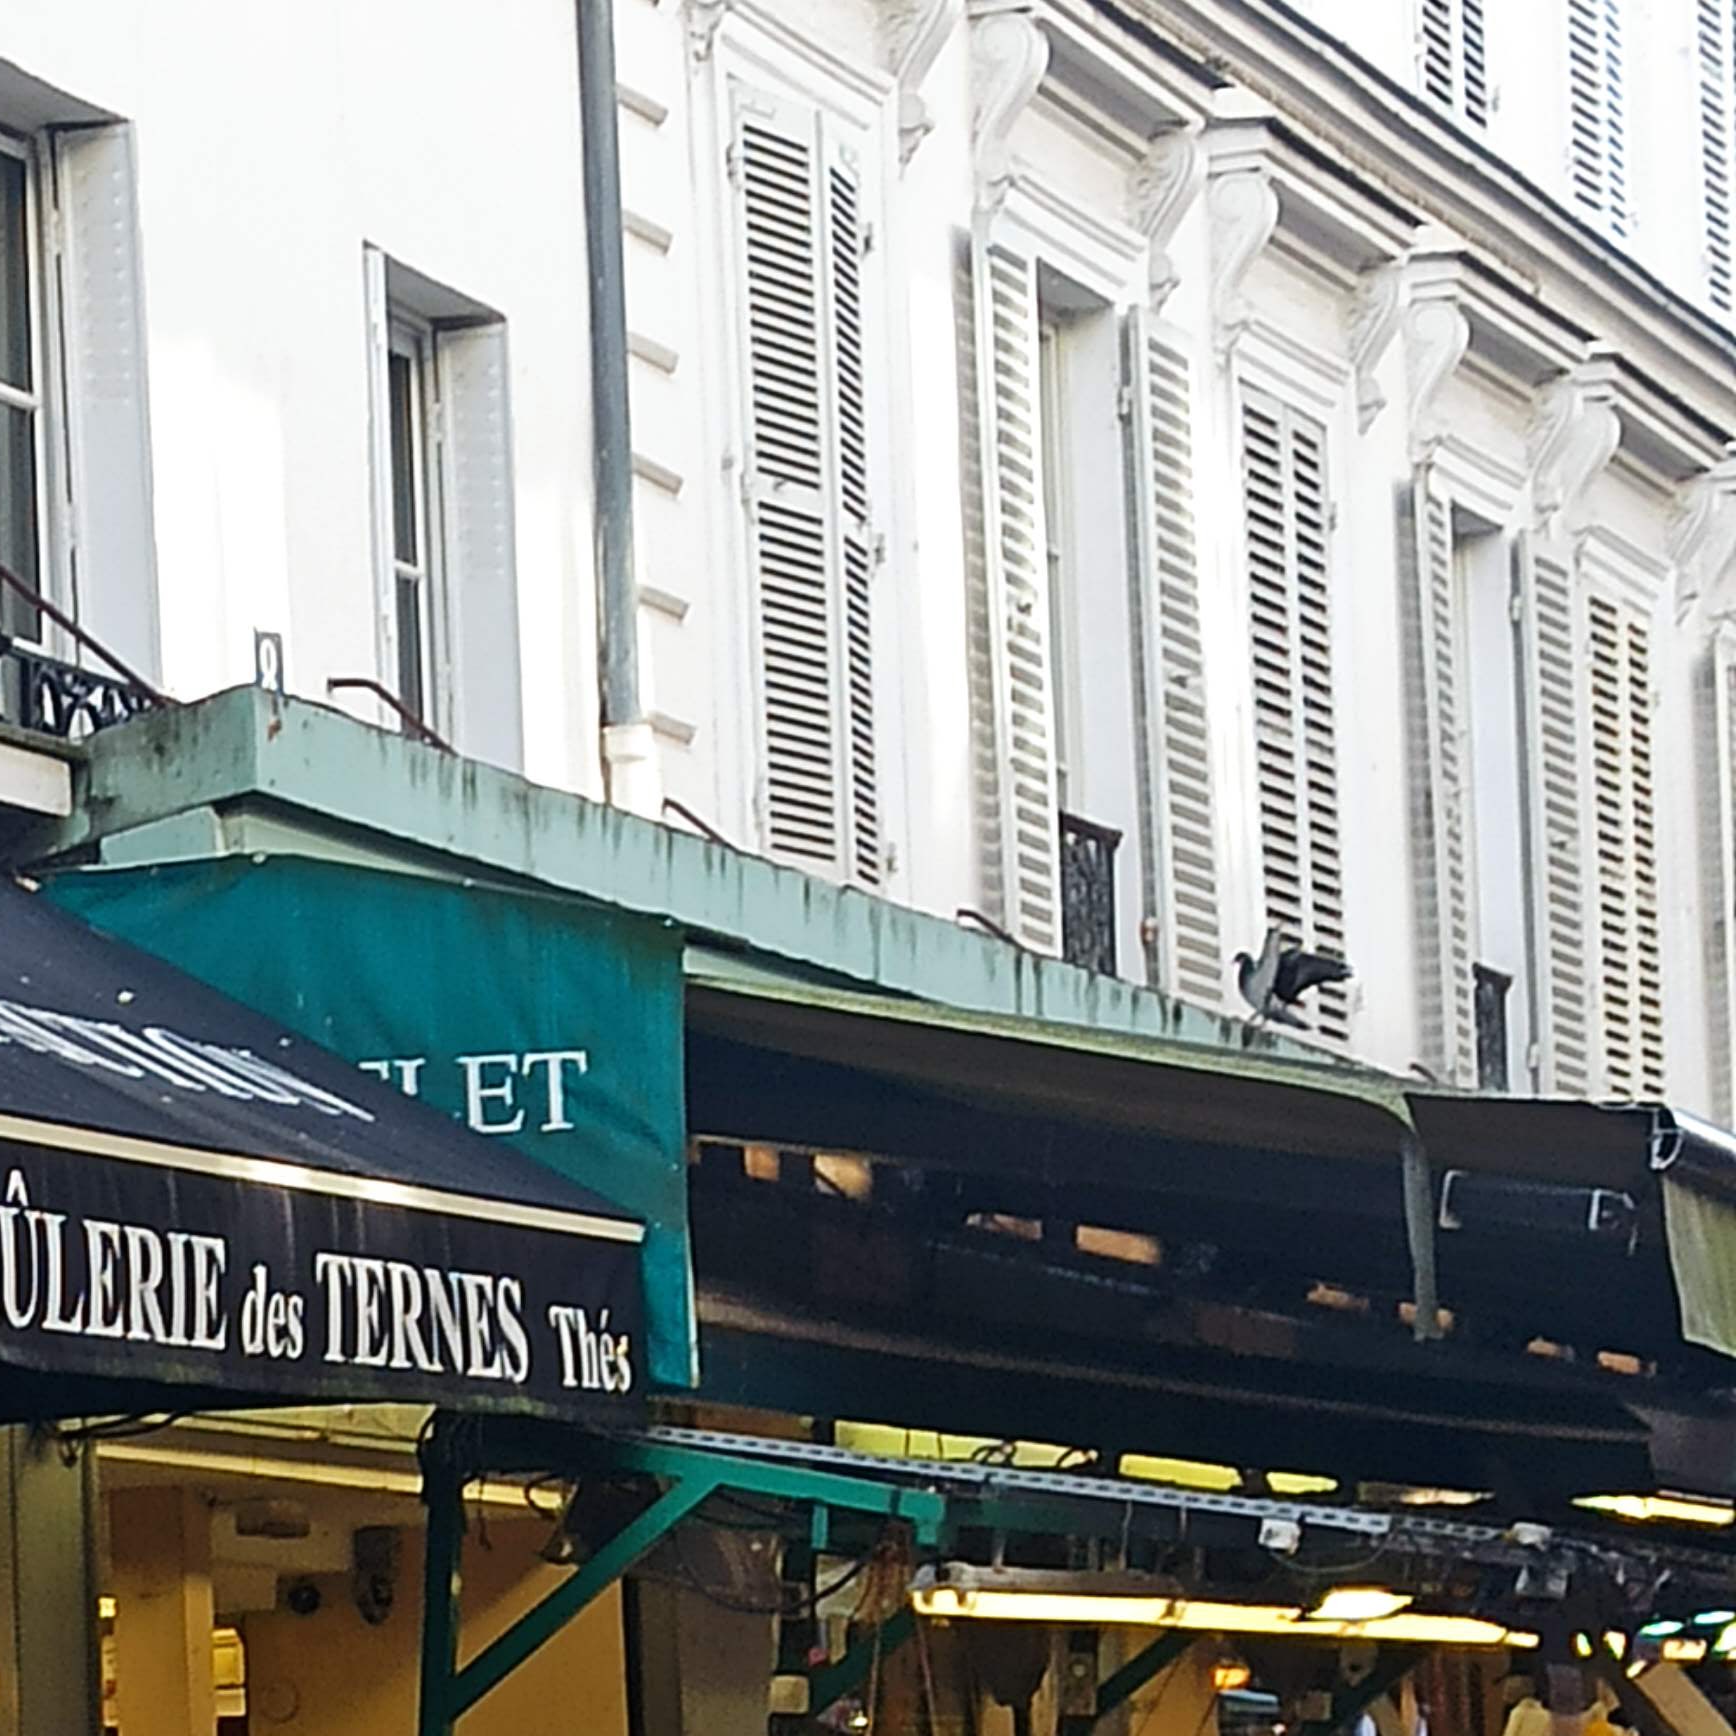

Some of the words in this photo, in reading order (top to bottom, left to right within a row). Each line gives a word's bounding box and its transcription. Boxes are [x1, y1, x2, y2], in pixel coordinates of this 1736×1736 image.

[241, 1263, 304, 1360] des
[314, 1252, 530, 1384] TERNES
[549, 1305, 634, 1392] Thés
